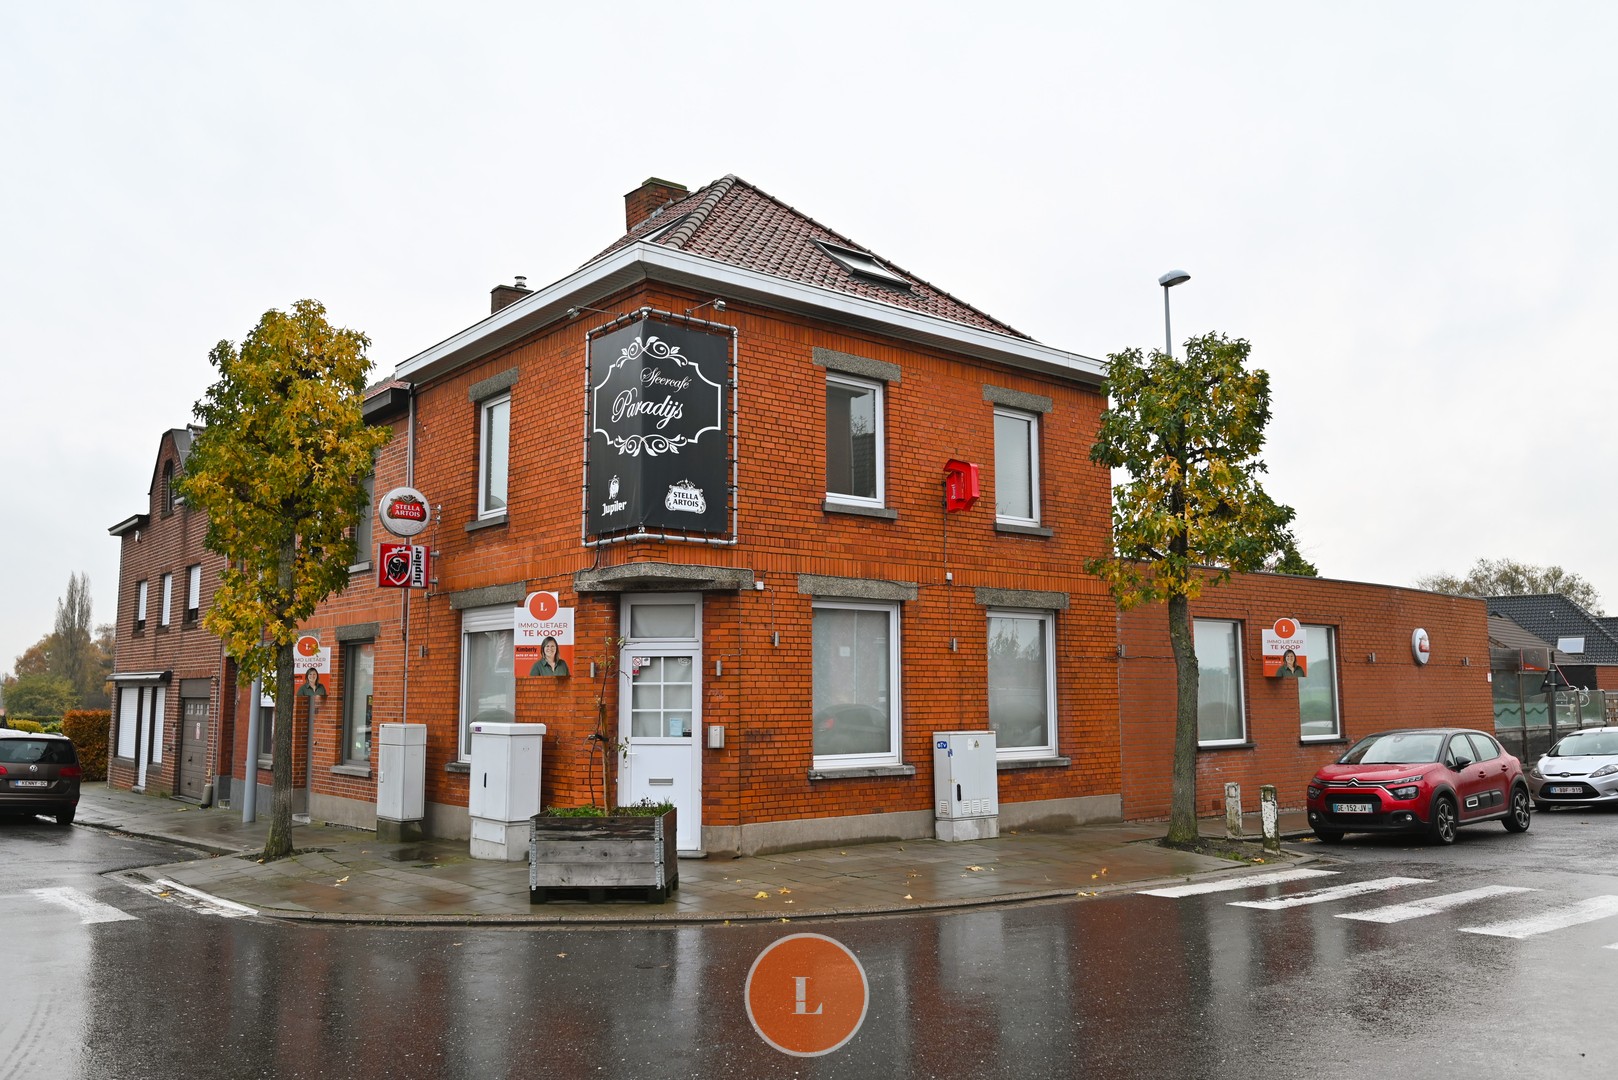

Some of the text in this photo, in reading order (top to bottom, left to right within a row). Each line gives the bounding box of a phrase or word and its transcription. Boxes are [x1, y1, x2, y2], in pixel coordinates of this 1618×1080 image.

[640, 367, 692, 393] Sfeercafé
[612, 388, 683, 430] Paradijs
[673, 491, 699, 501] STELLA
[395, 503, 421, 512] STELLA
[673, 498, 699, 508] ARTOIS
[601, 500, 628, 517] Jupiler
[413, 547, 423, 586] Jupiler
[540, 602, 547, 611] L
[523, 629, 564, 637] TE KOOP
